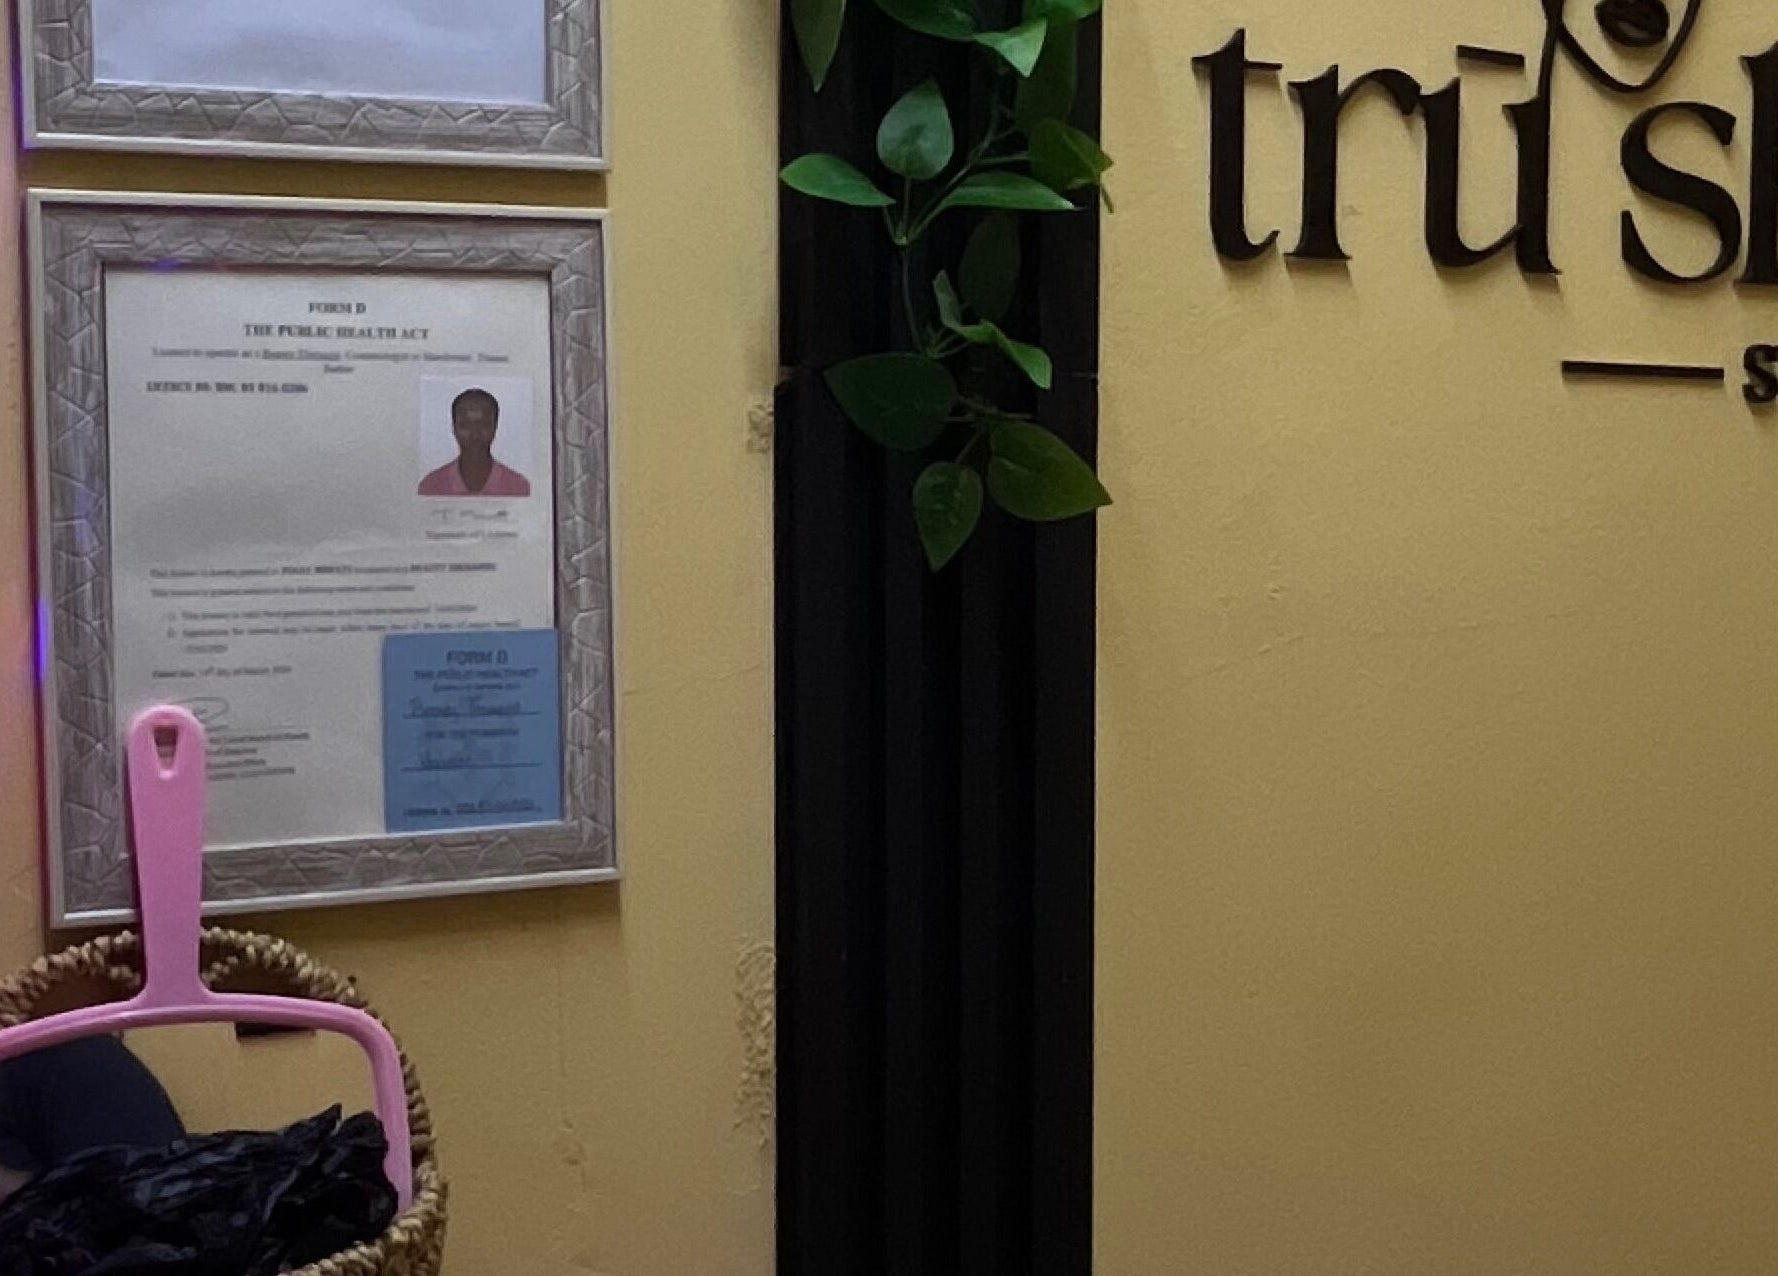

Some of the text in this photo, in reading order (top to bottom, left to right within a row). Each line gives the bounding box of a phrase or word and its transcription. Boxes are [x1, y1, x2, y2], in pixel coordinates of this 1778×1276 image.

[308, 302, 352, 314] FORM
[244, 324, 429, 340] THE PUBLIC HEALTH ACT
[446, 650, 493, 664] FORM
